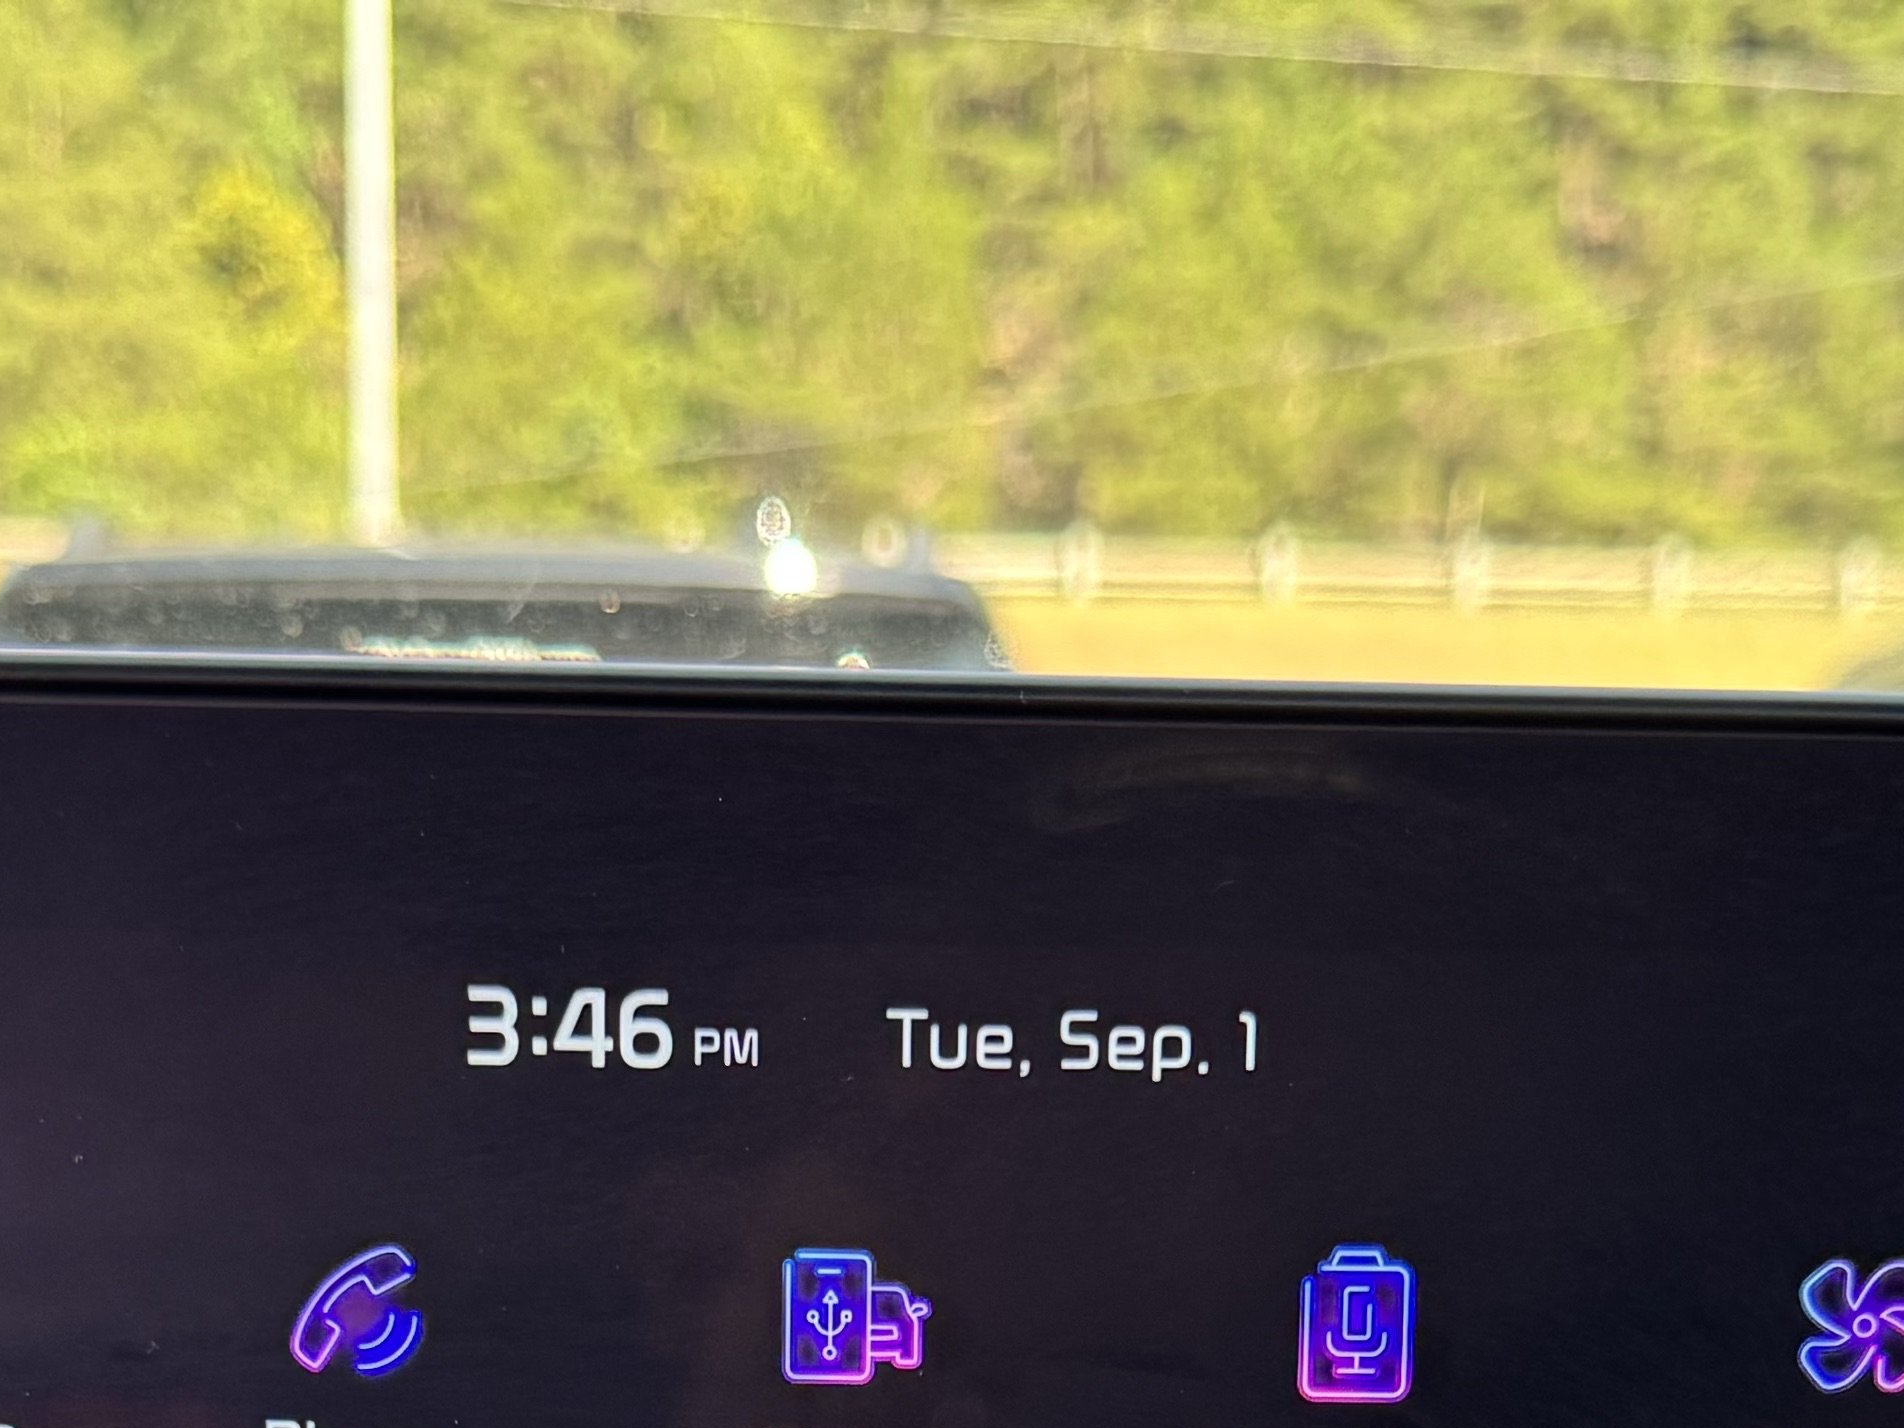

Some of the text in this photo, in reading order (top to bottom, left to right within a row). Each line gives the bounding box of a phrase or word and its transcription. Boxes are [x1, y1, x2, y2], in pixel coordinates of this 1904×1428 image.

[467, 985, 758, 1069] 3:46 PM
[886, 1008, 1256, 1082] Tue, Sep. 1
